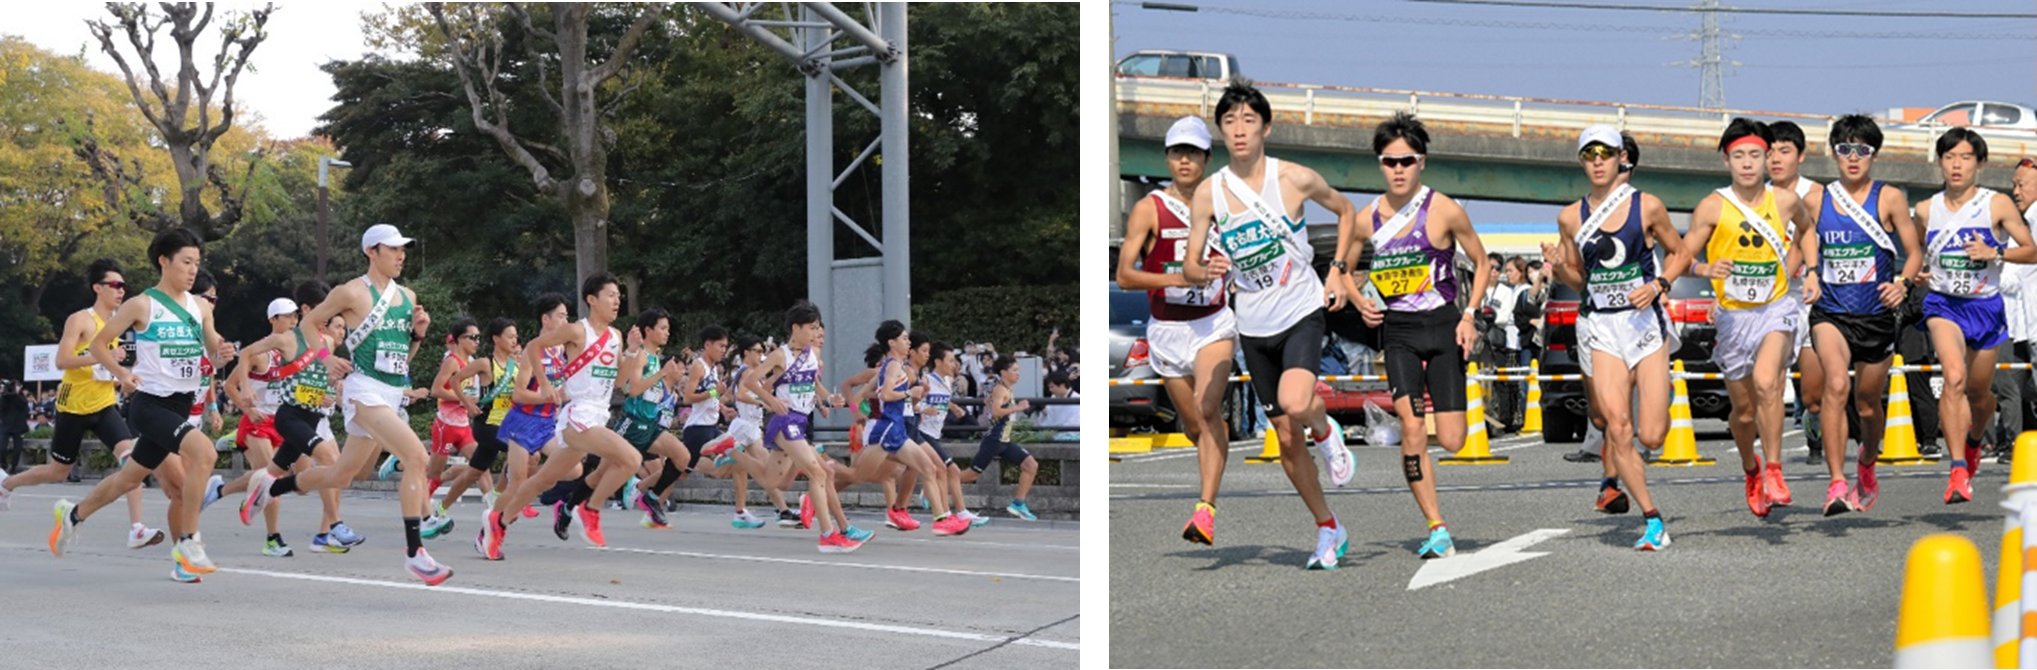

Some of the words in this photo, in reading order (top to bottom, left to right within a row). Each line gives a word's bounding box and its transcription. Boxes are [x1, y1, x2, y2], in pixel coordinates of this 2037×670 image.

[1825, 230, 1853, 245] IPU
[1732, 263, 1777, 274] 谷工グループ
[1255, 274, 1274, 290] 19
[1838, 269, 1856, 283] 24
[1391, 279, 1410, 295] 27
[1747, 287, 1757, 301] 9
[1953, 281, 1970, 295] 25
[1186, 290, 1205, 304] 21
[1607, 292, 1626, 306] 23
[598, 350, 615, 366] C
[180, 366, 193, 378] 19
